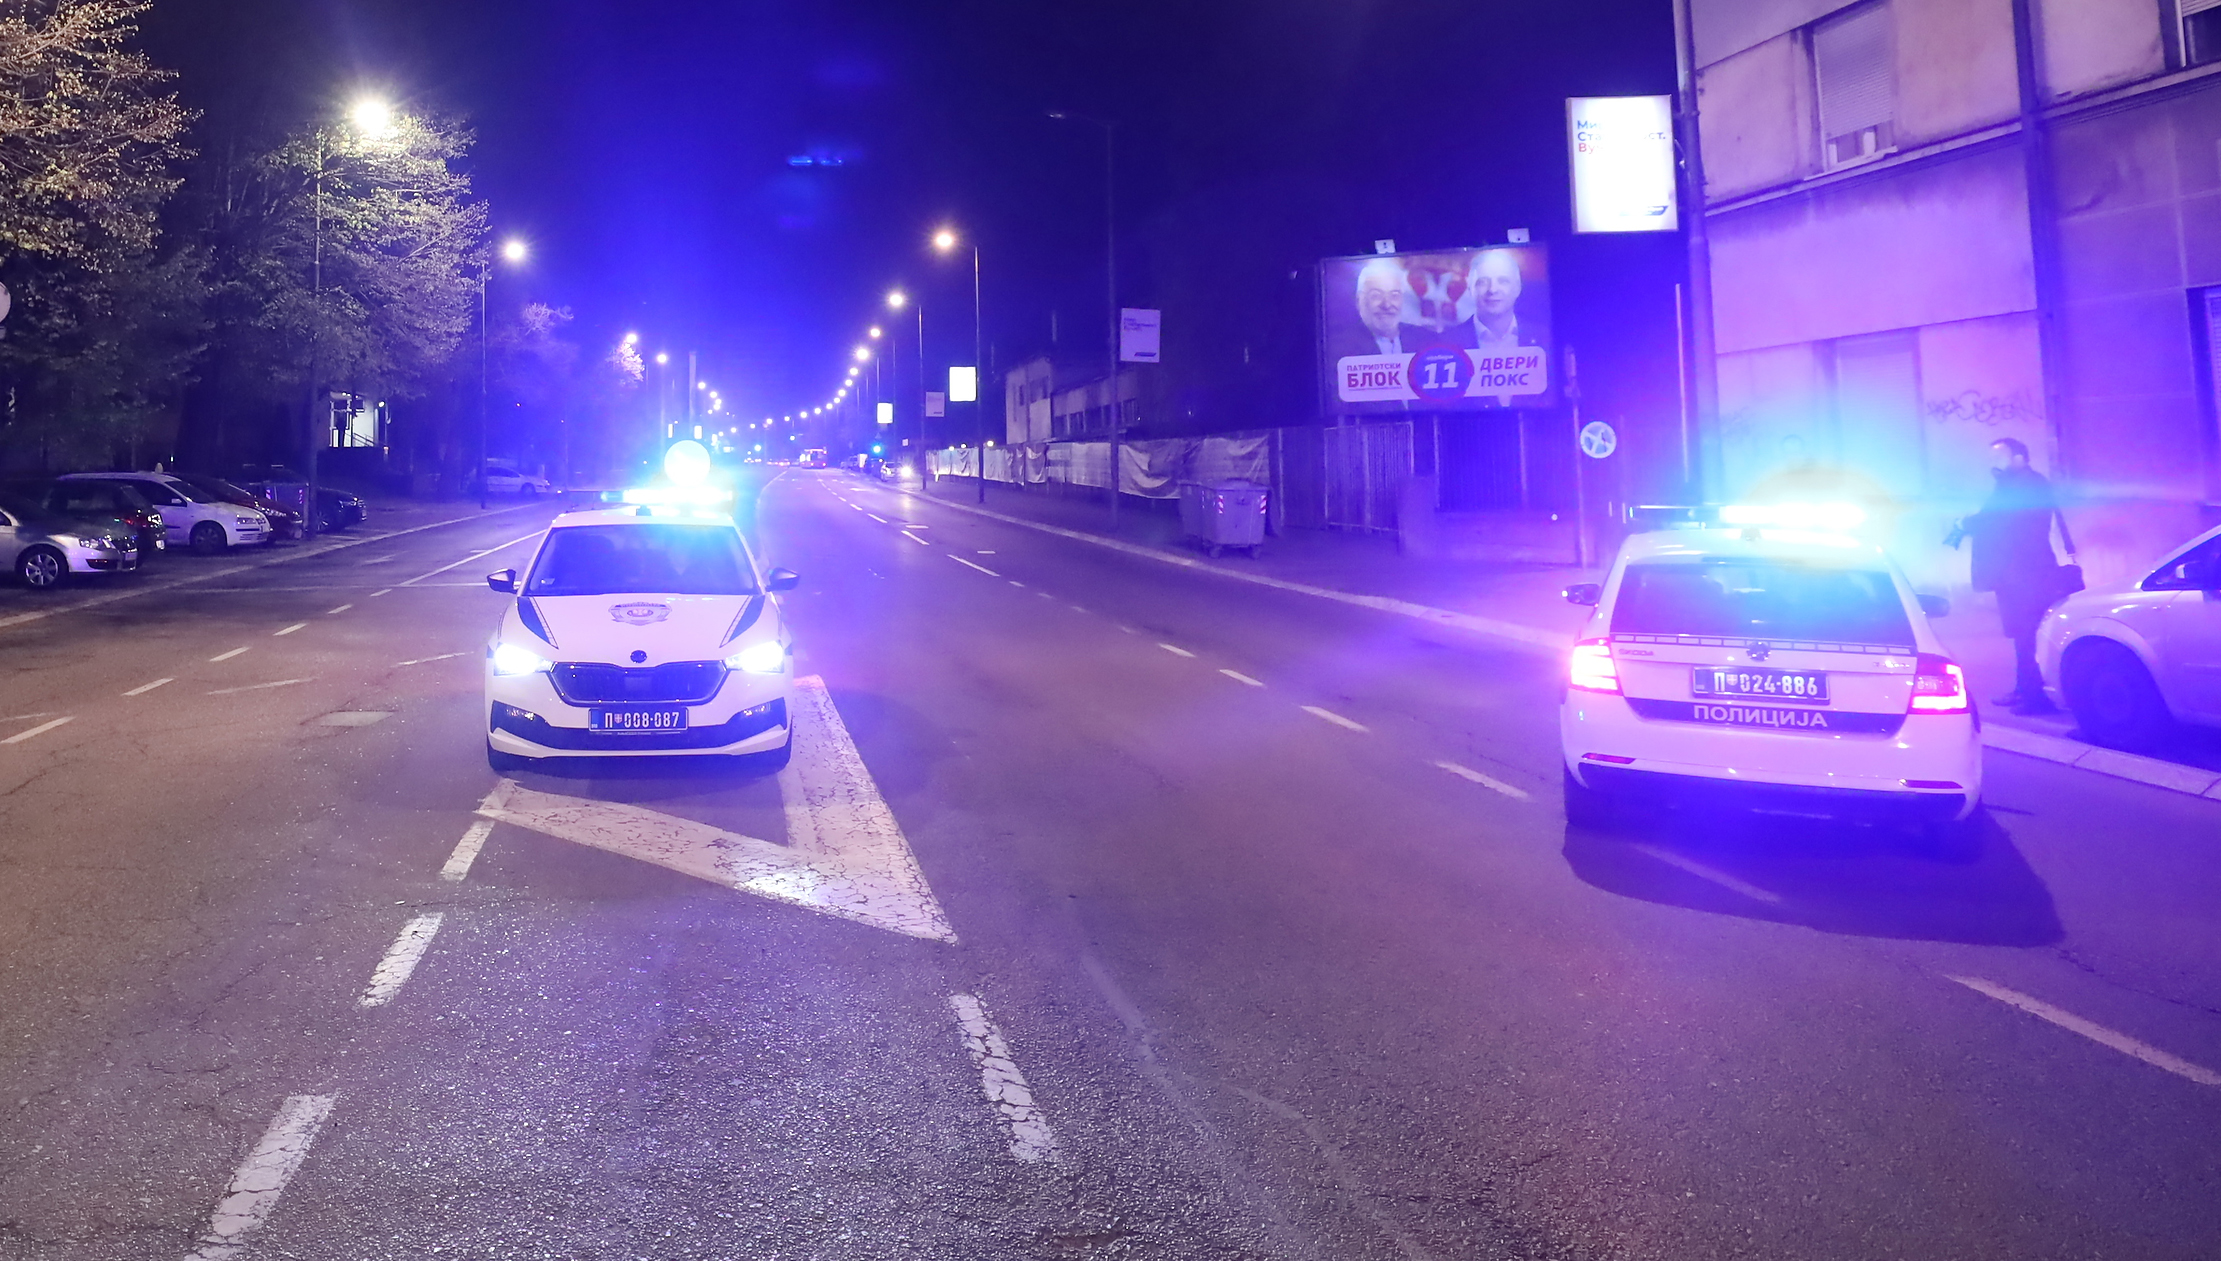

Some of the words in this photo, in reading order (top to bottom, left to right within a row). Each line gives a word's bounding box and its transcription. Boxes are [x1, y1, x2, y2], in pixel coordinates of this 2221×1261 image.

[1480, 356, 1539, 373] ДВЕРИ
[1347, 371, 1402, 388] БЛОК
[1422, 362, 1459, 389] 11
[1481, 373, 1529, 388] ПОКС
[1693, 704, 1829, 728] ПОЛИЦИЈА
